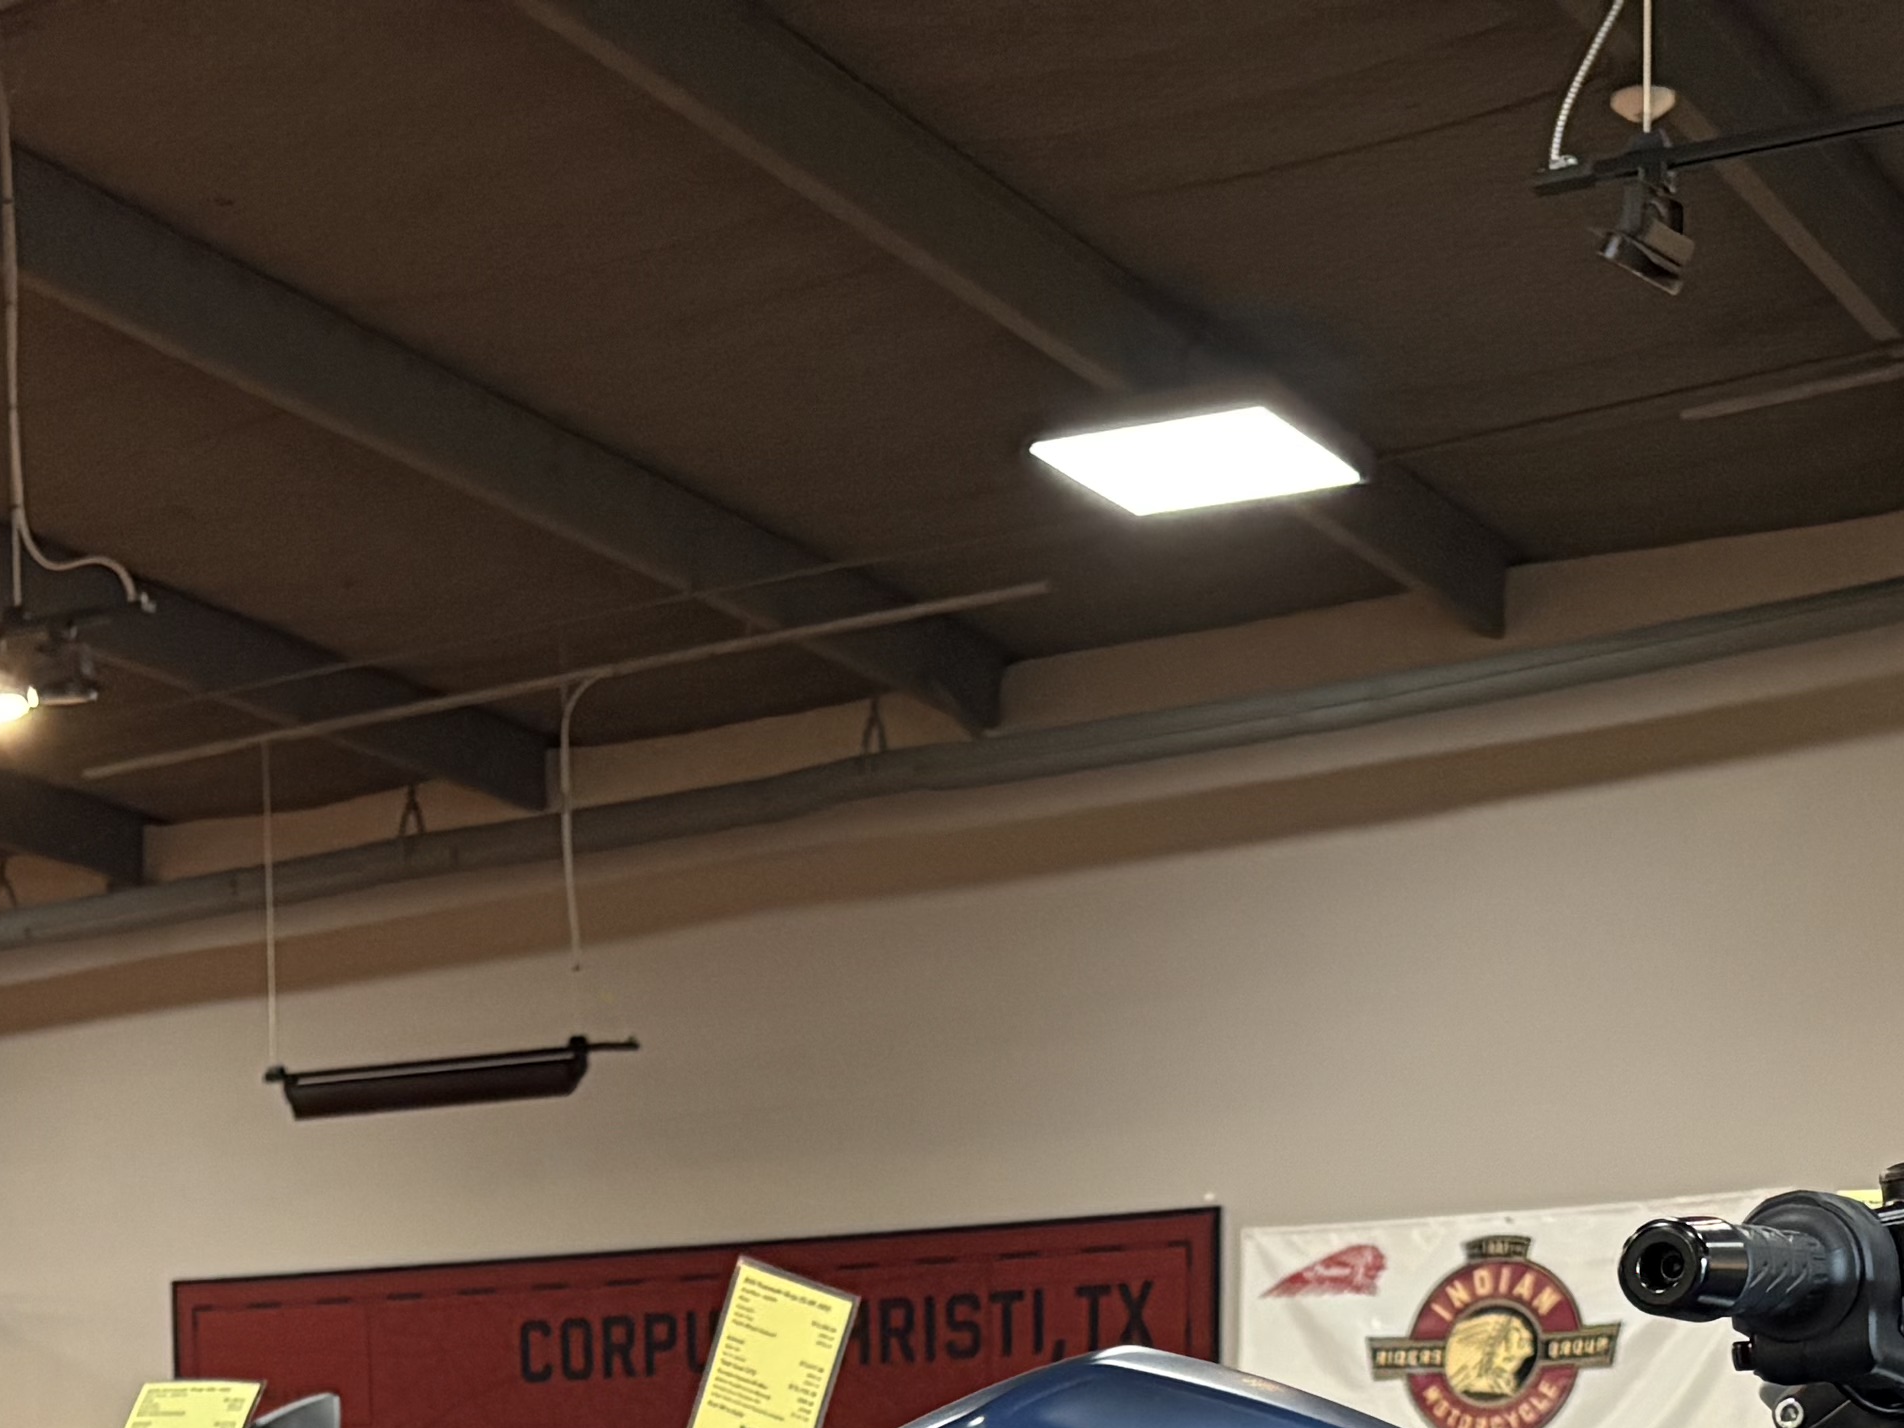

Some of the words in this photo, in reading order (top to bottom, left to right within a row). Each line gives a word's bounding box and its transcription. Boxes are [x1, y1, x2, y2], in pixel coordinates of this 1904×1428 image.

[1431, 1266, 1562, 1322] INDIAN
[520, 1309, 723, 1384] CORPU
[1376, 1348, 1443, 1367] RIDERS
[1547, 1336, 1611, 1359] GROUP
